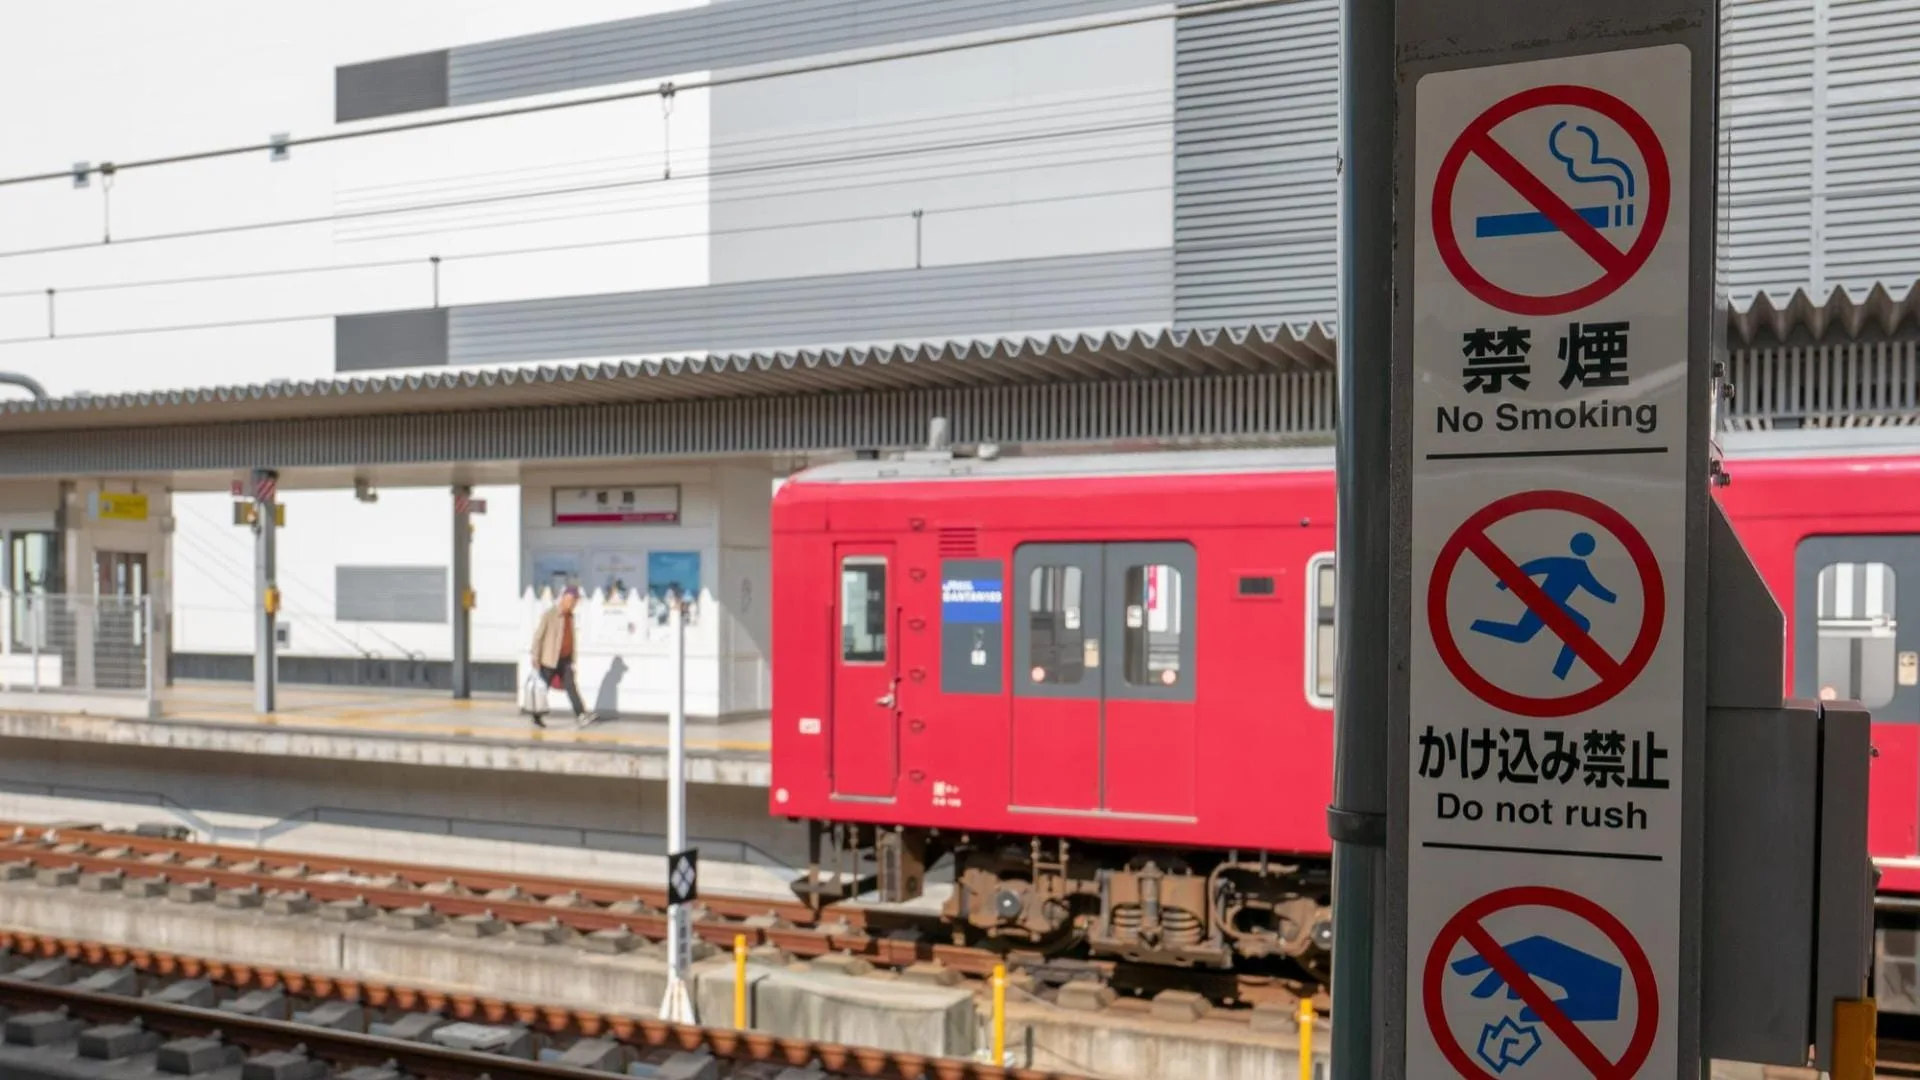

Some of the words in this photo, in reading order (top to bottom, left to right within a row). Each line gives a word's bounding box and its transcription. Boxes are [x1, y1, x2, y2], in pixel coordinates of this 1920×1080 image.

[1461, 320, 1631, 395] 禁煙
[1436, 405, 1484, 434] No
[1495, 399, 1657, 434] Smoking
[1418, 724, 1670, 790] かけ込み禁止
[1437, 791, 1484, 822] Do
[1495, 798, 1554, 826] not
[1565, 800, 1648, 830] rush
